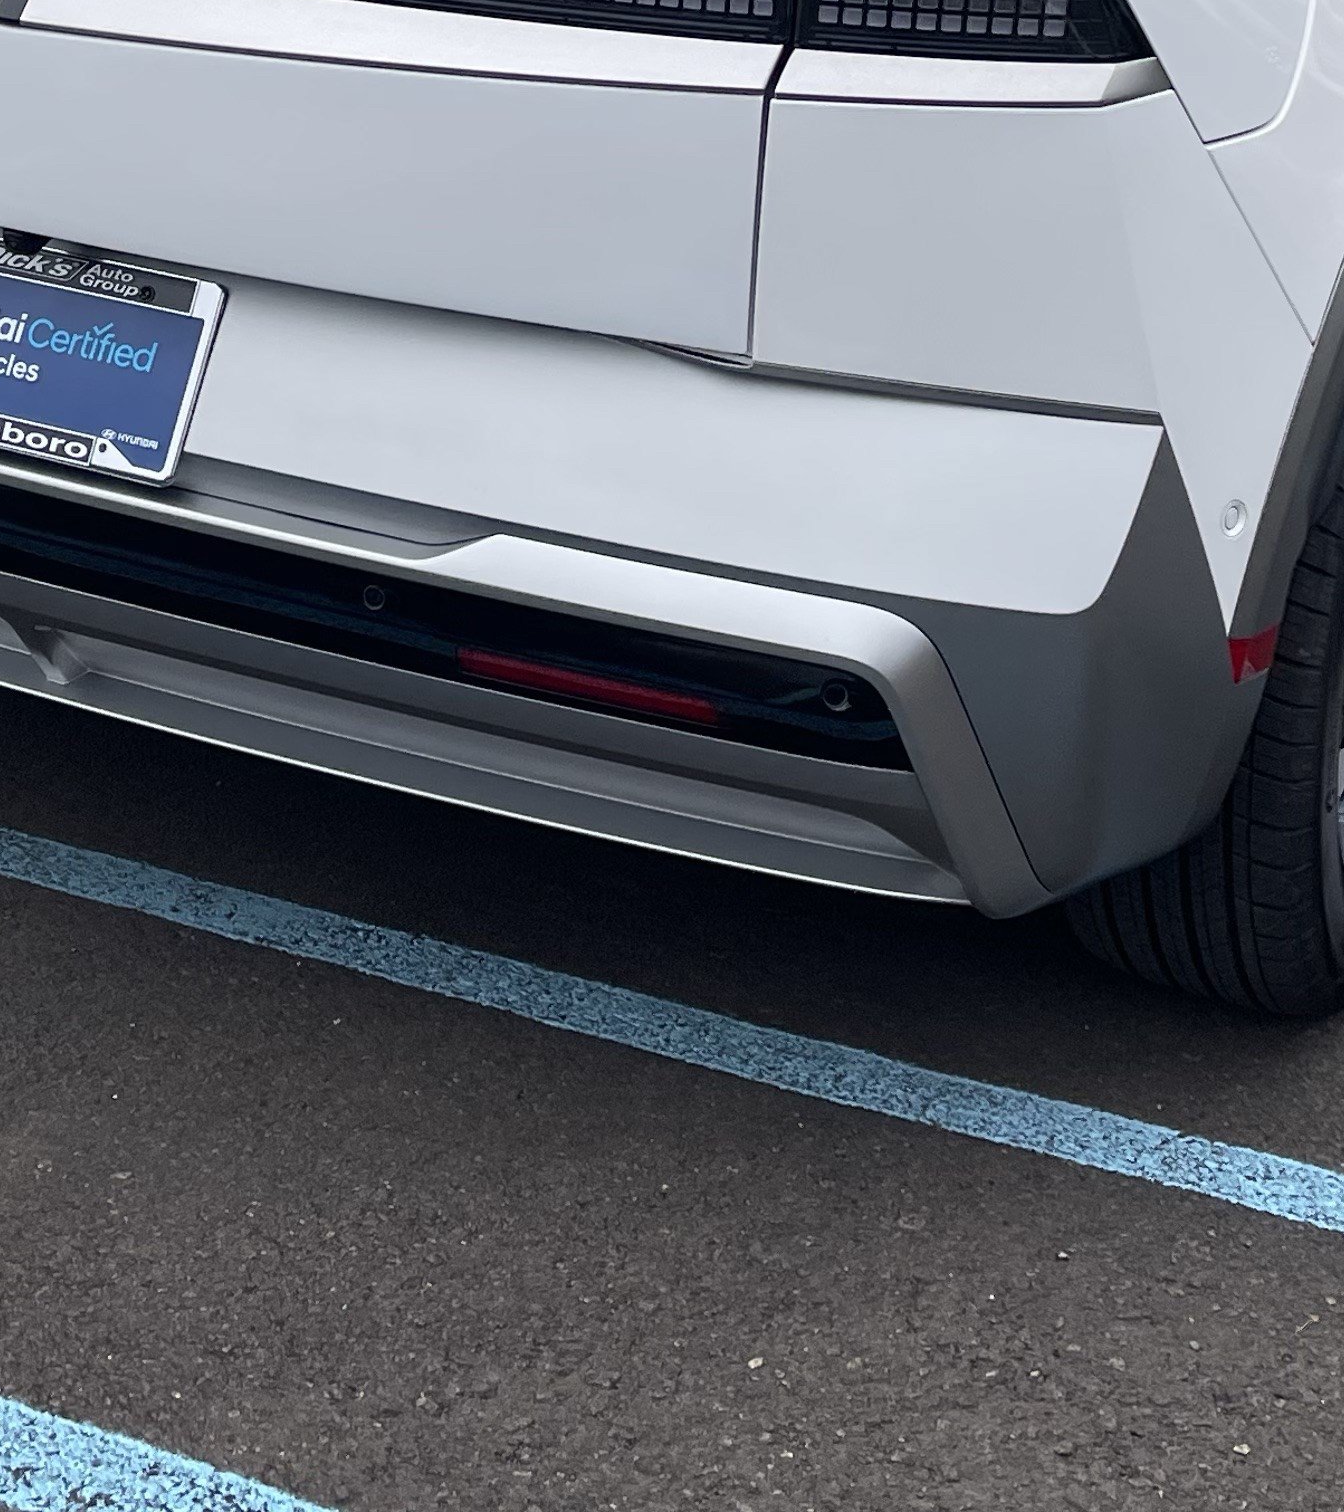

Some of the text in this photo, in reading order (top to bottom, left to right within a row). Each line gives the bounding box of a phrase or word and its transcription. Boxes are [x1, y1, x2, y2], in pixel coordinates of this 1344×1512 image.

[87, 263, 134, 283] Auto
[79, 274, 140, 298] Group
[27, 317, 159, 373] Certified
[117, 432, 159, 450] HYUNDAI
